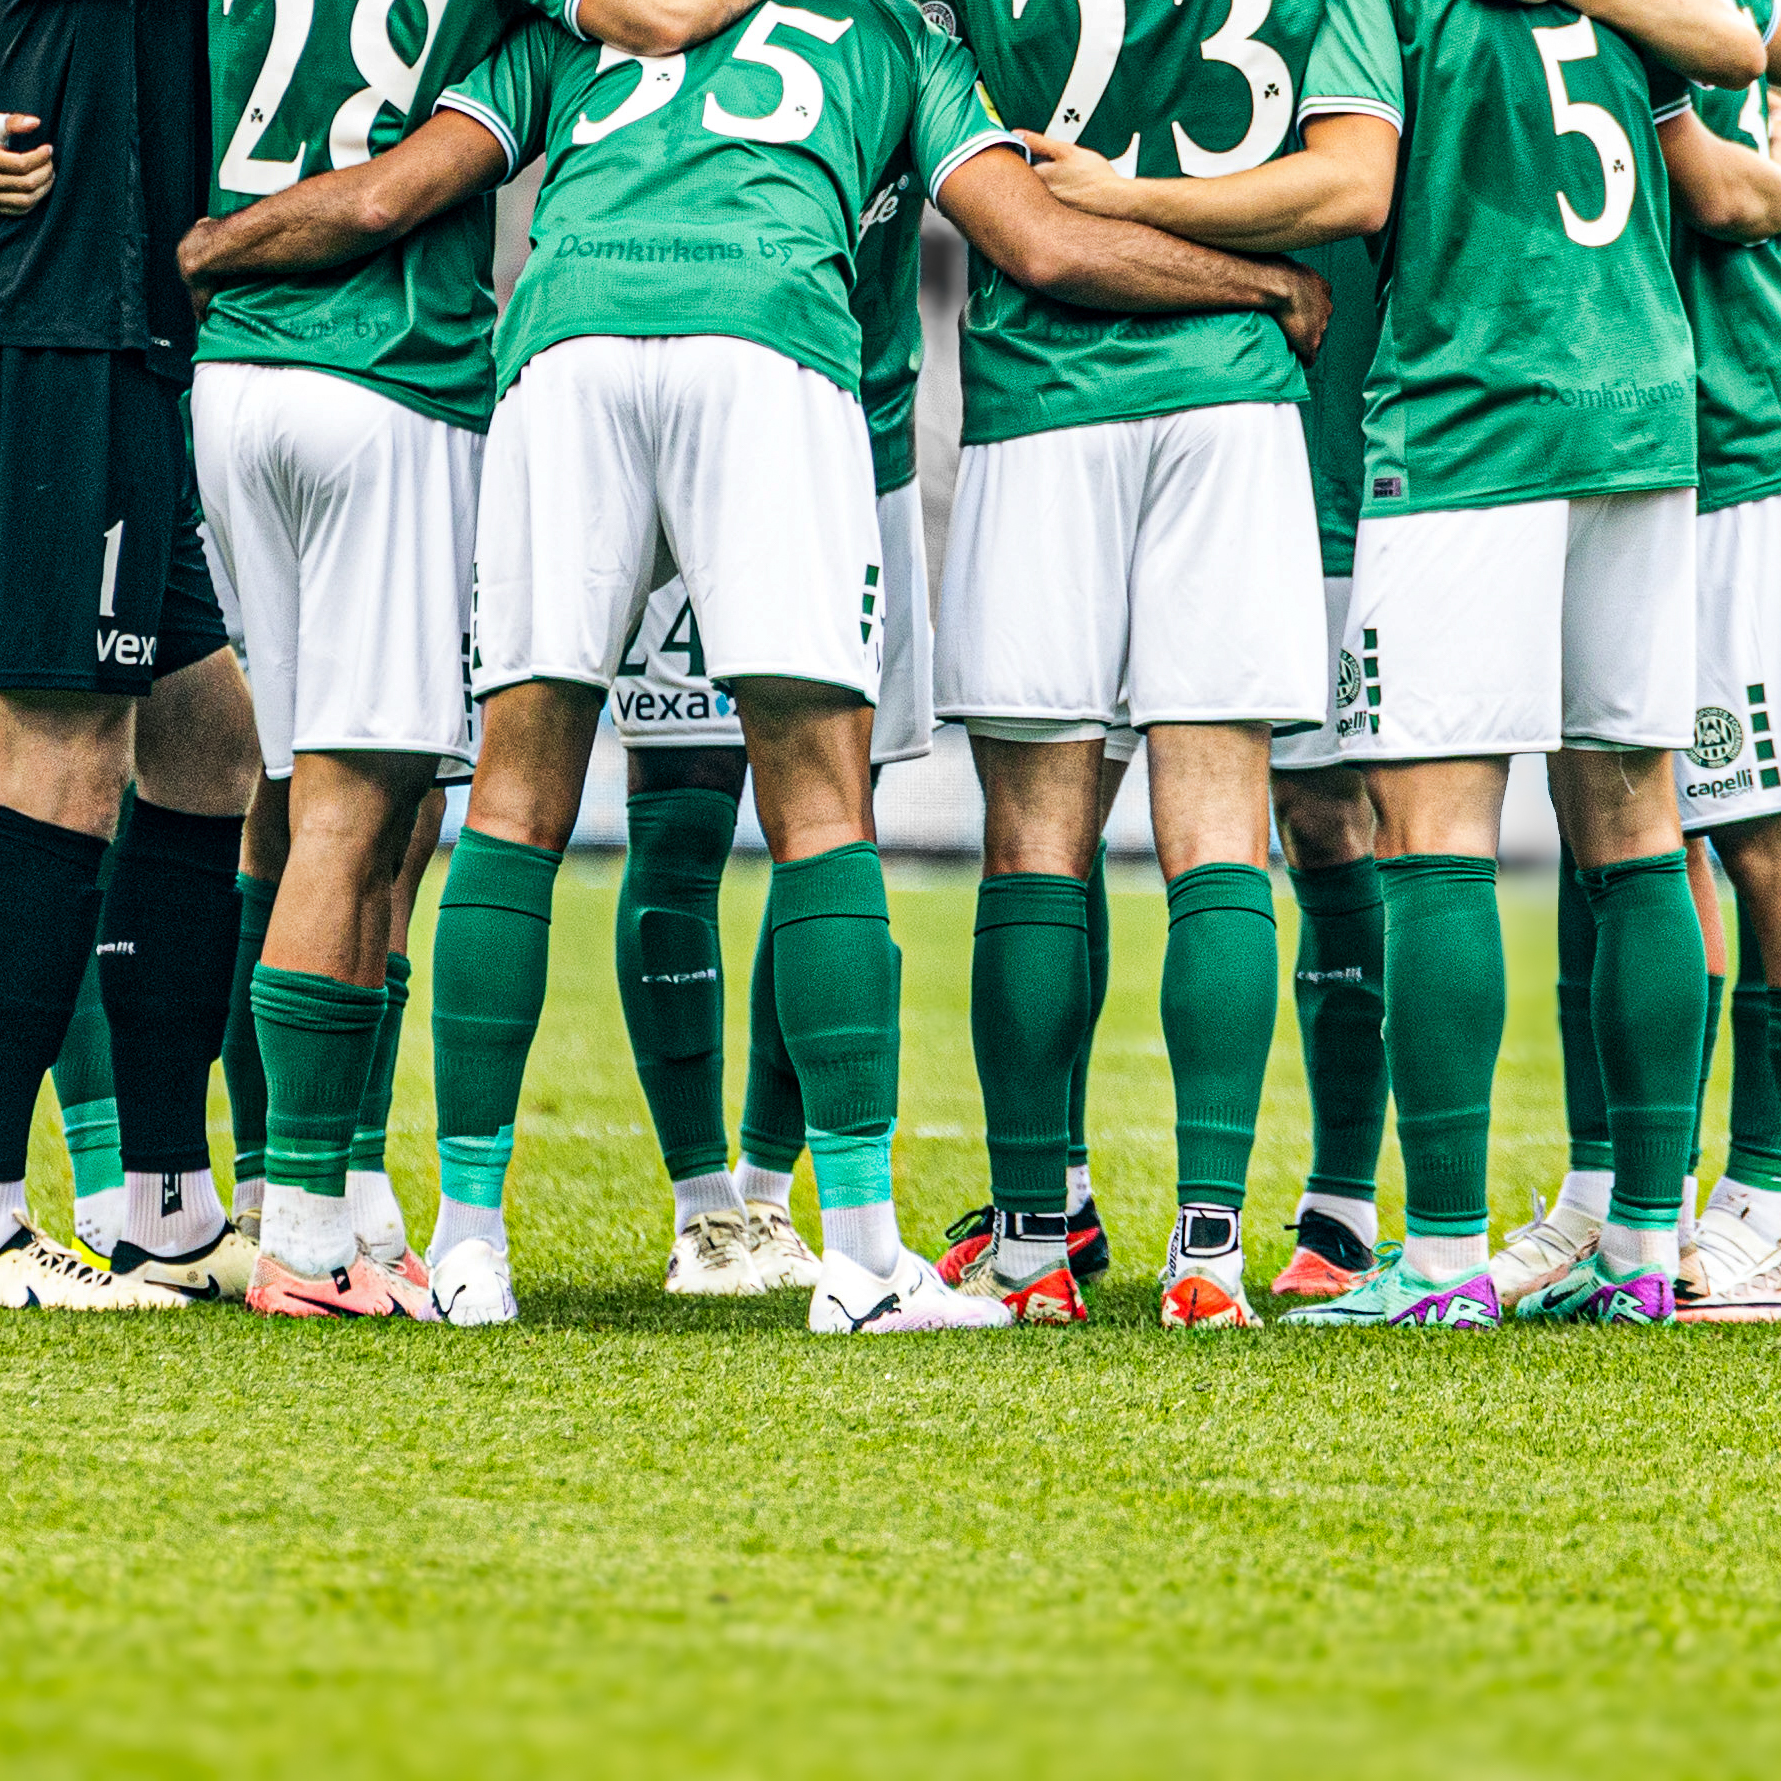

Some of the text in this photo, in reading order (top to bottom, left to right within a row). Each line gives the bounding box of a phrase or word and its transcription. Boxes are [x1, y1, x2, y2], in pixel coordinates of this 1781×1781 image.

[1531, 14, 1636, 248] 5
[553, 234, 793, 267] Domkirkens by
[99, 519, 125, 617] 1
[1686, 768, 1754, 799] capelli
